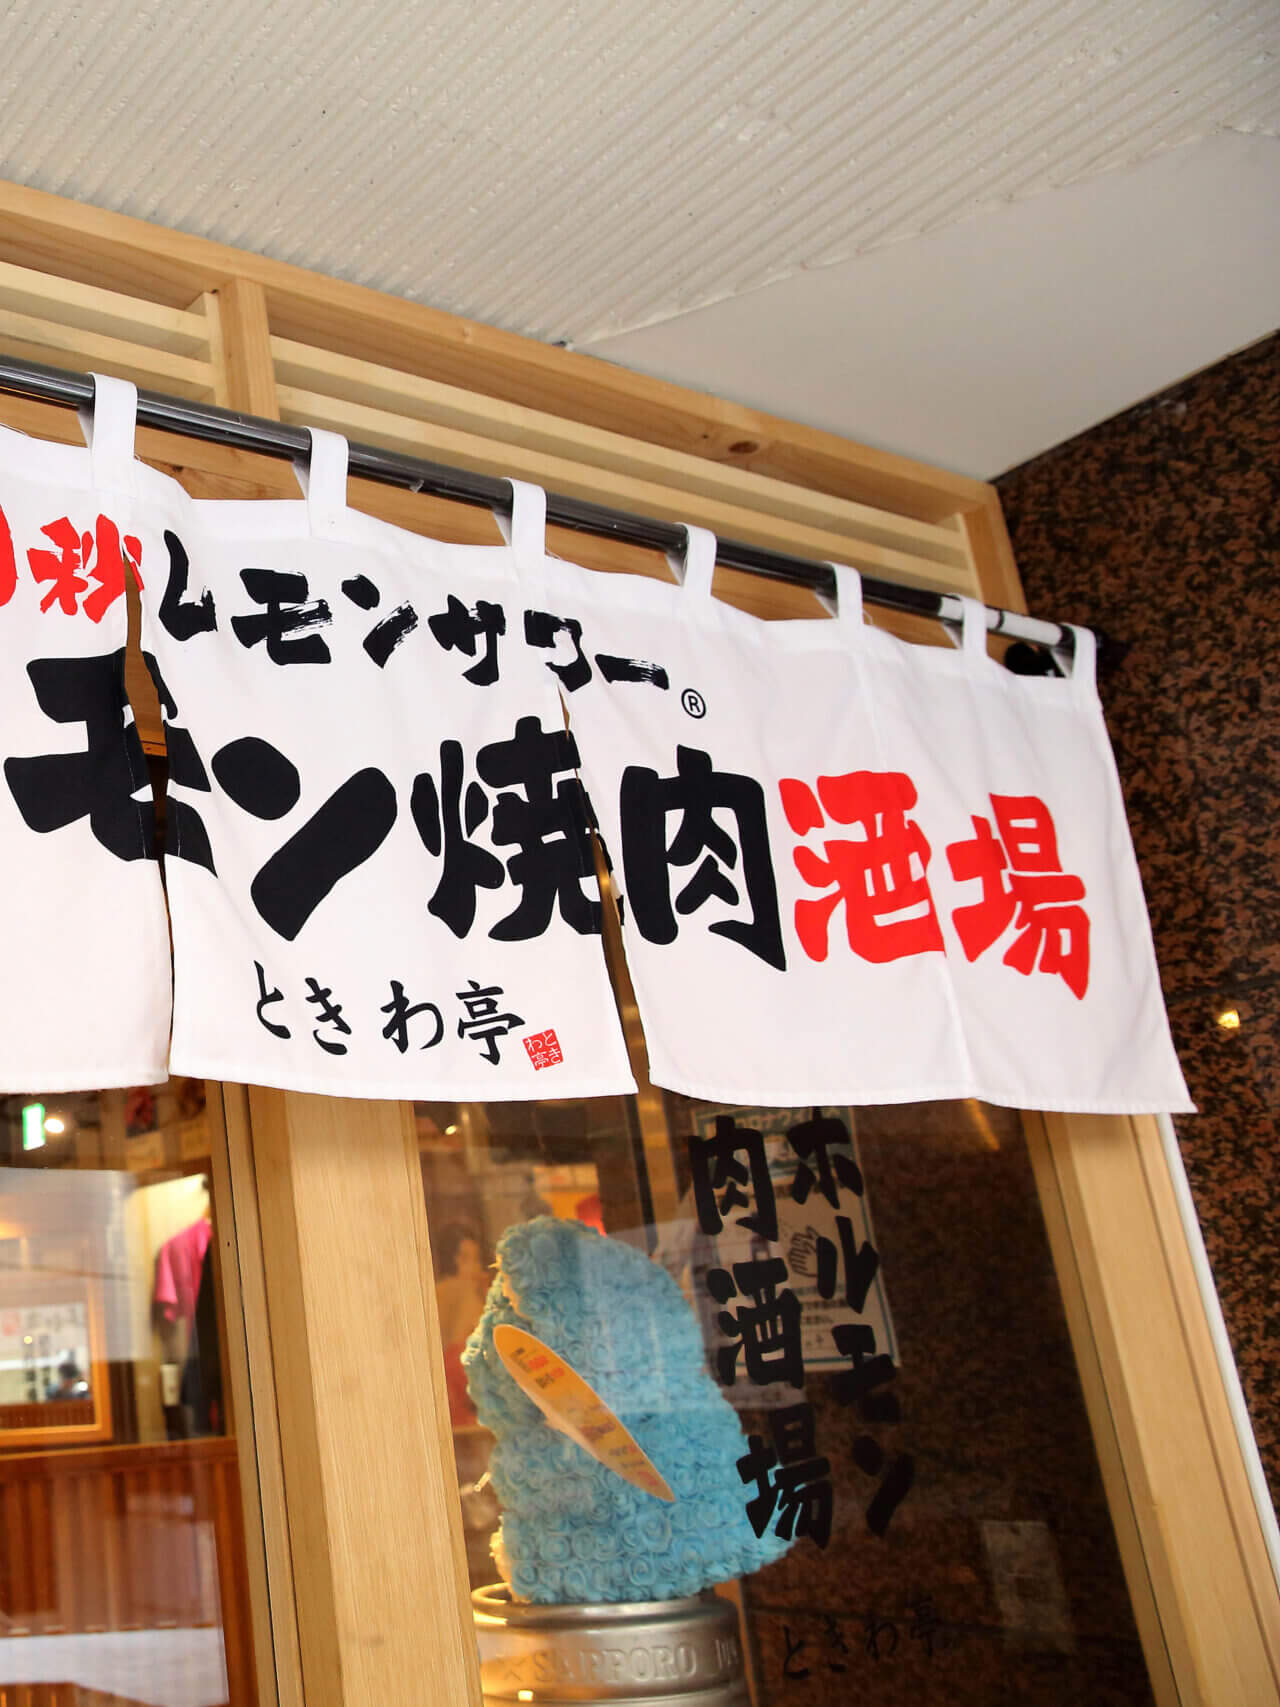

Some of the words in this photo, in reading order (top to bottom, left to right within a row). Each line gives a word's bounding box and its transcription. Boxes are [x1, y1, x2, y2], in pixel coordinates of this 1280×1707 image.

[254, 960, 526, 1066] ときわ亭
[688, 1115, 834, 1550] 肉酒場
[786, 1106, 916, 1537] ホルモン
